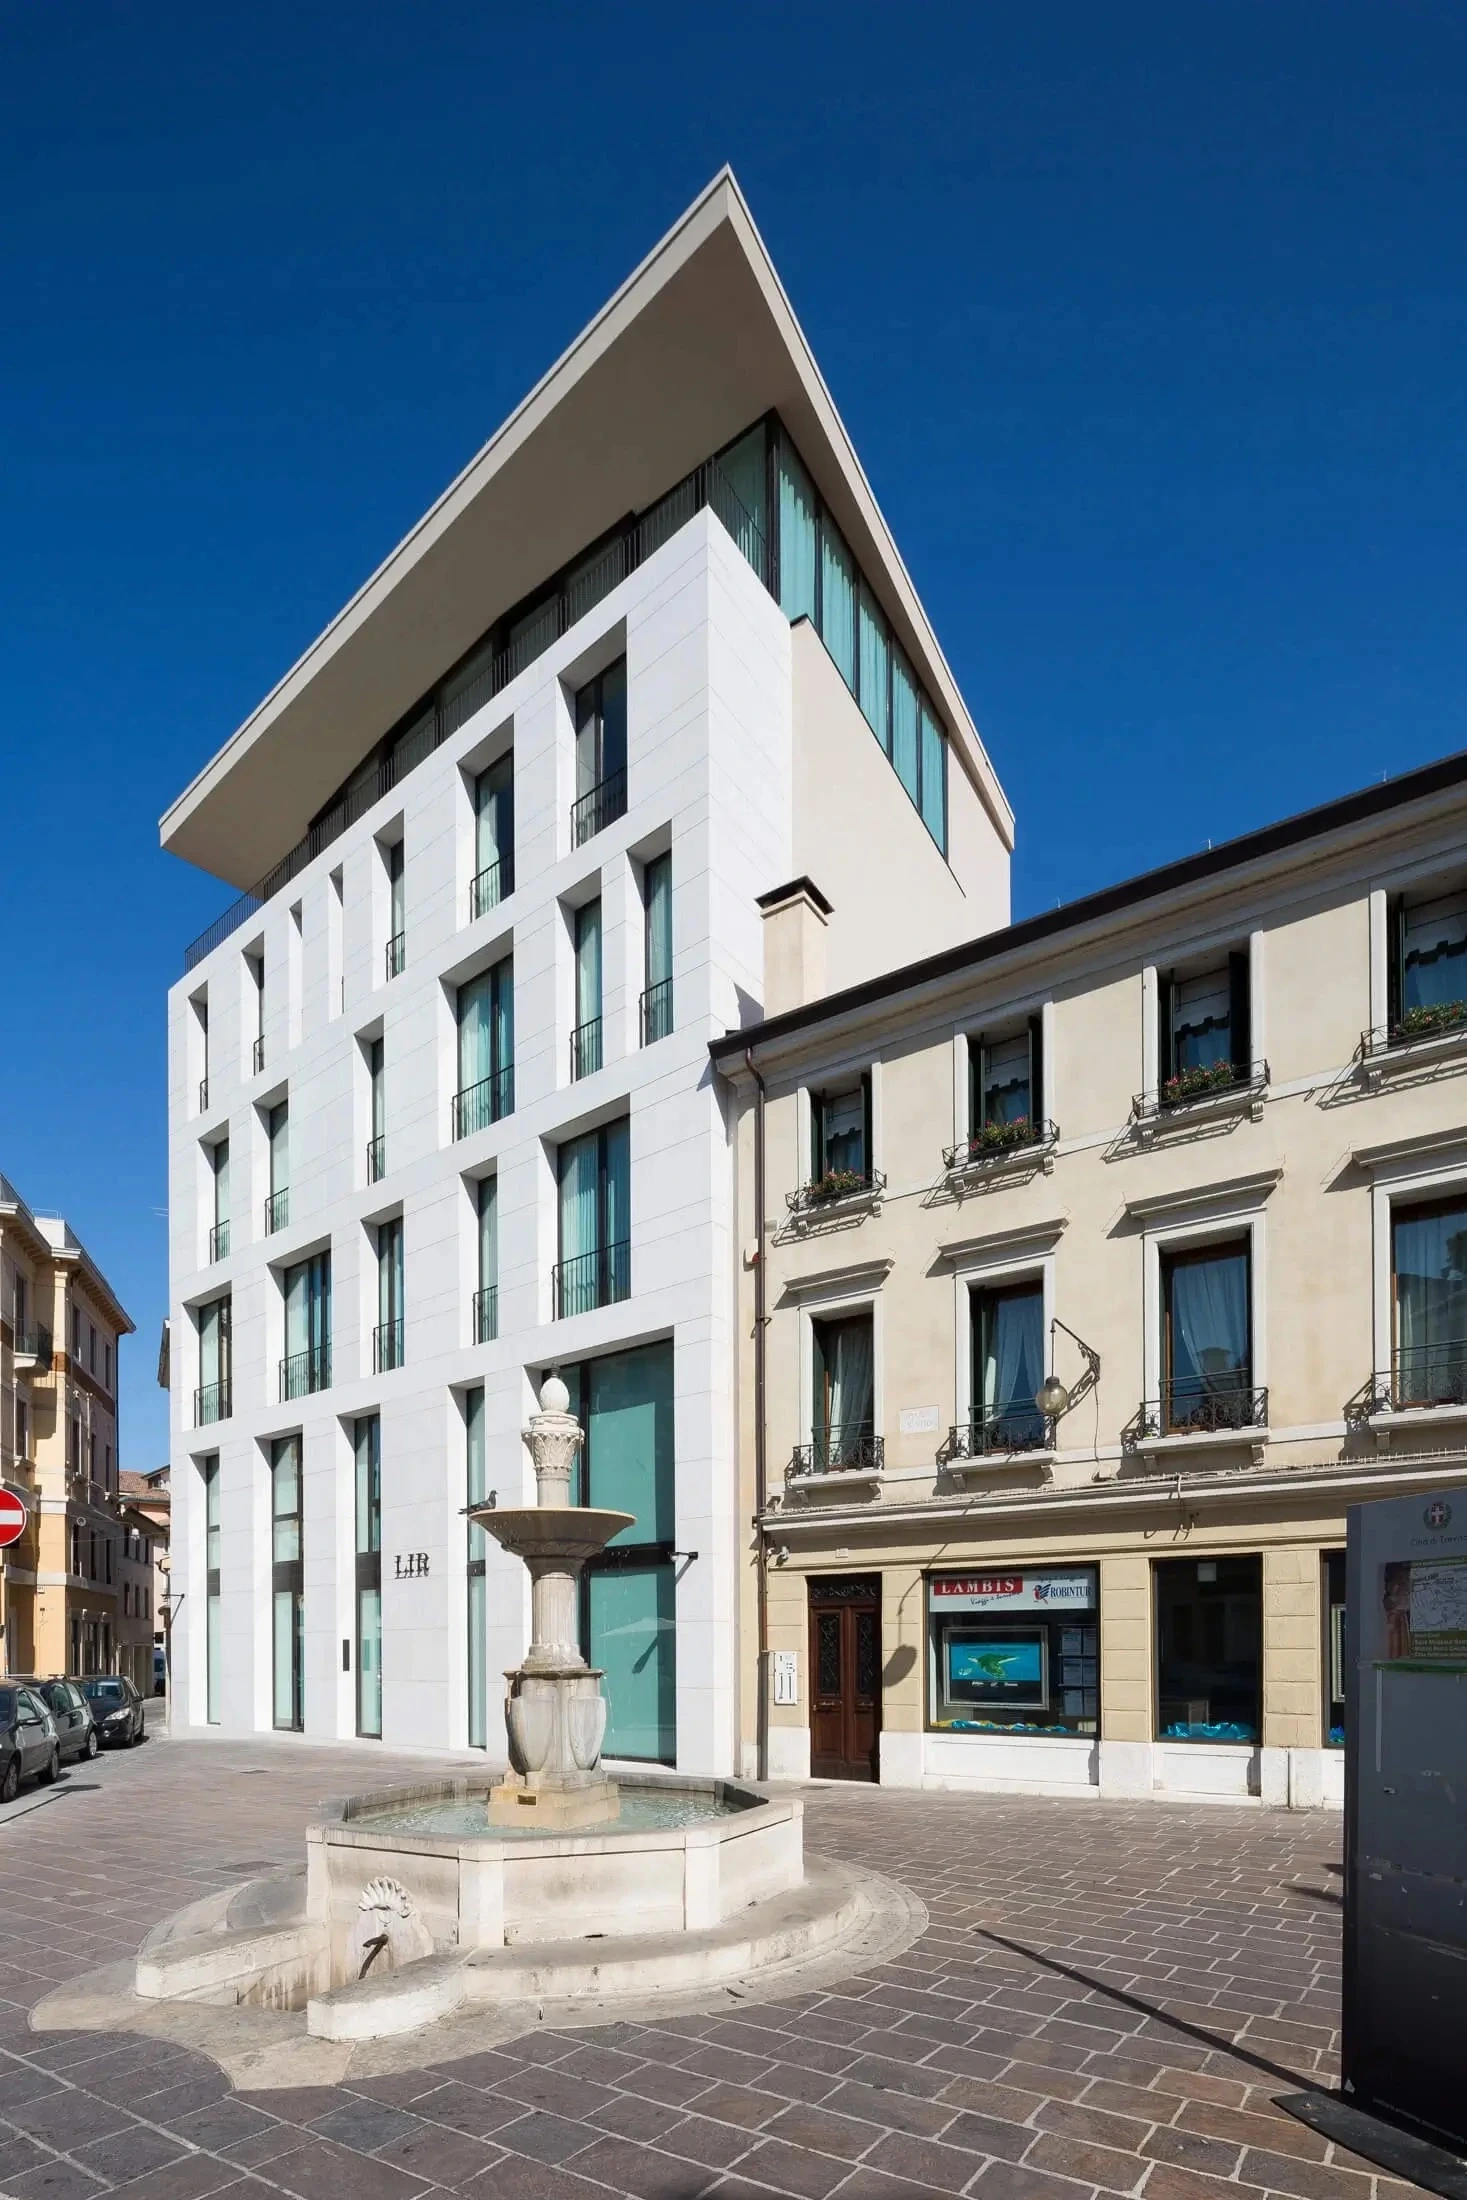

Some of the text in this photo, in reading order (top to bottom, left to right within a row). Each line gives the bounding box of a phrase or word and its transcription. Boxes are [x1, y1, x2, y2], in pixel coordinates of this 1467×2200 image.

[394, 1552, 430, 1579] LIR
[941, 1578, 1015, 1594] LAMBIS
[1050, 1585, 1092, 1598] ROBINTUR
